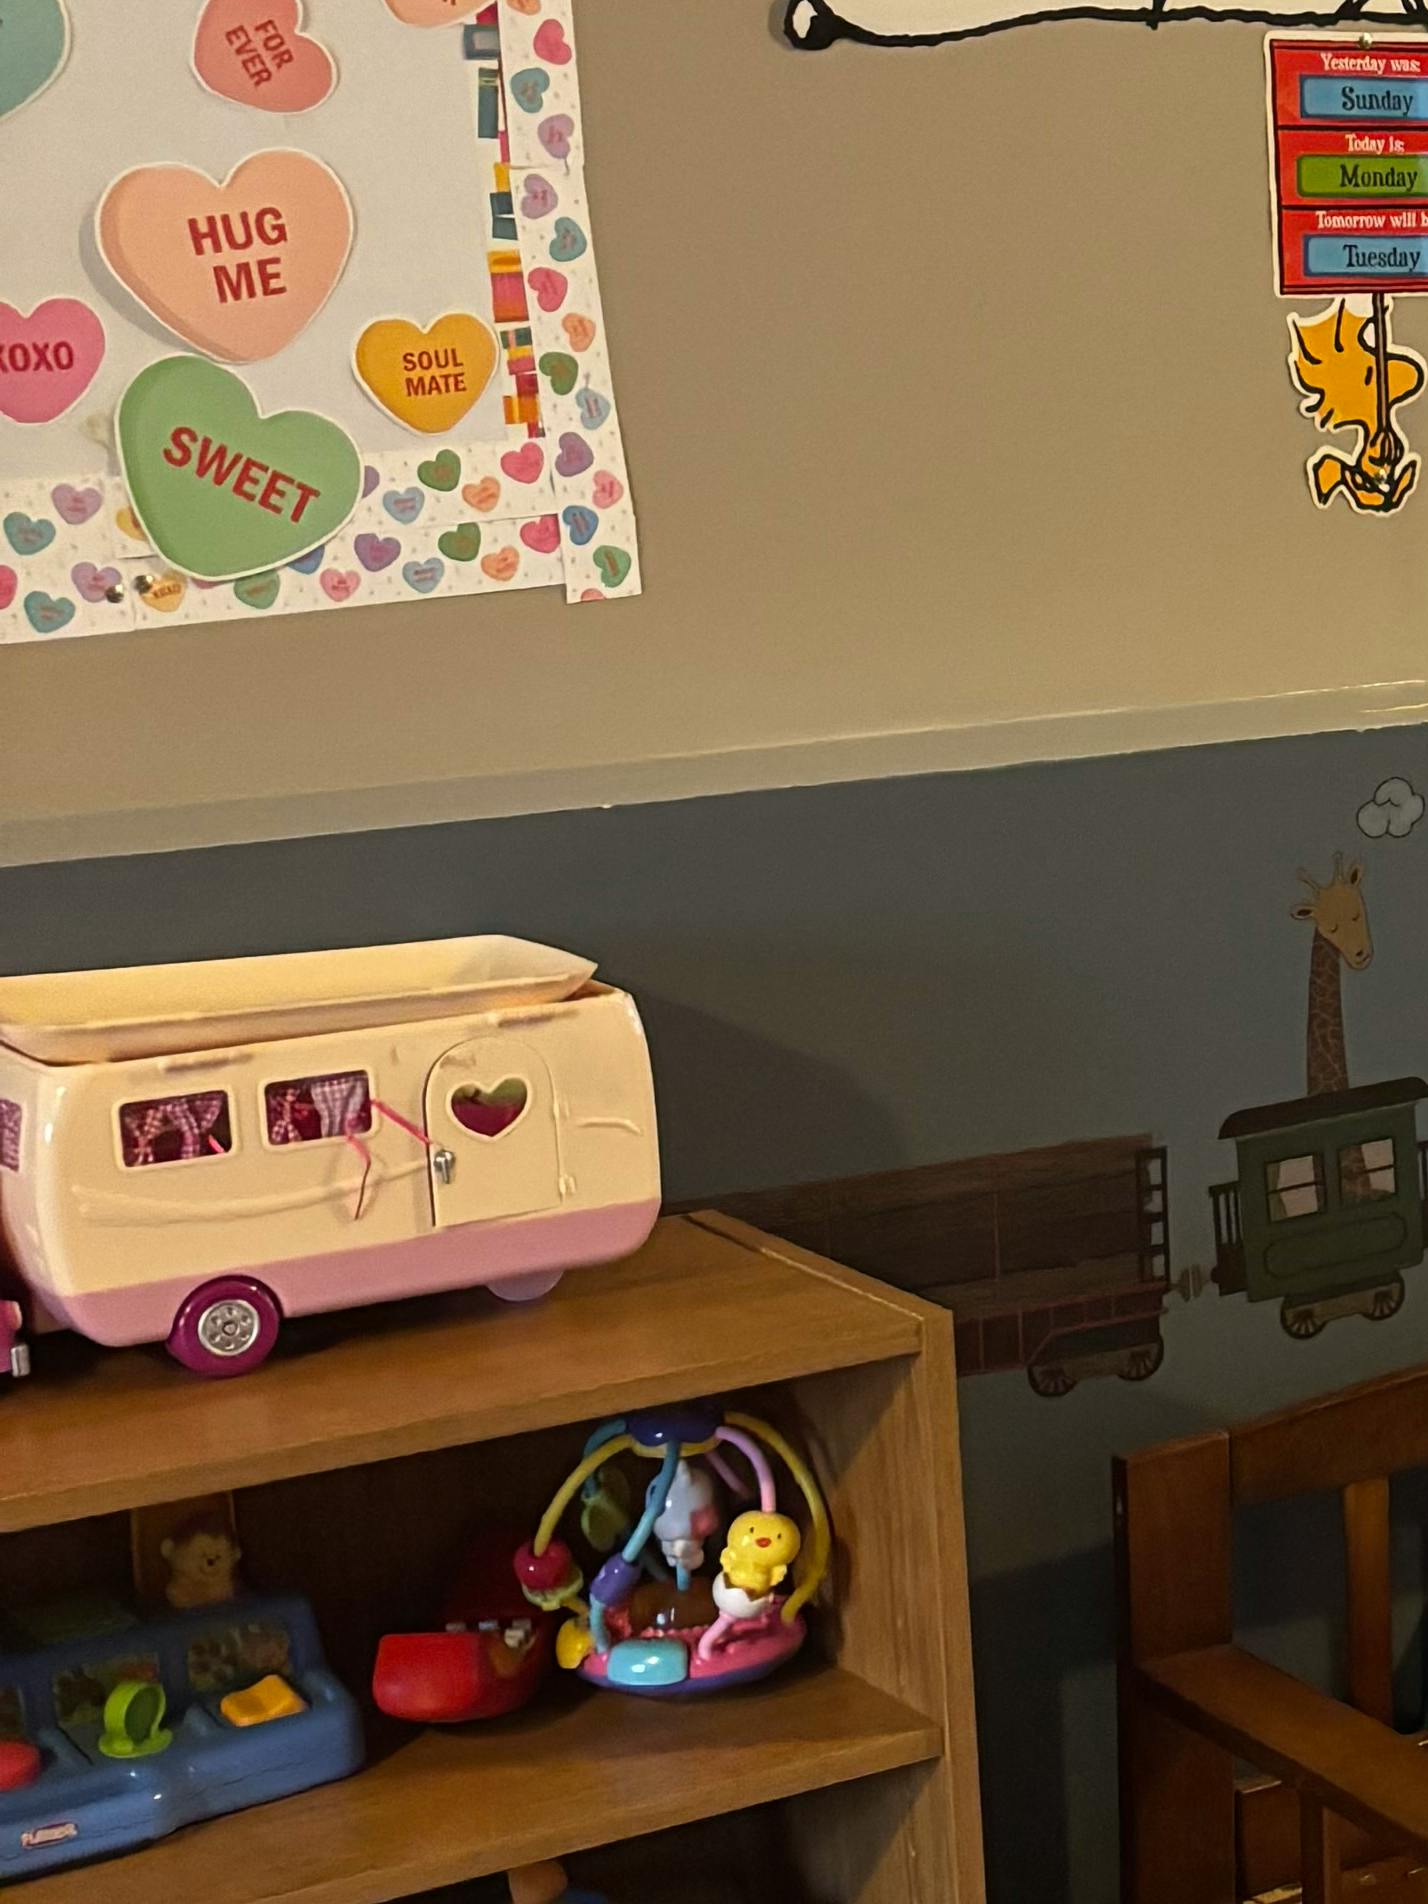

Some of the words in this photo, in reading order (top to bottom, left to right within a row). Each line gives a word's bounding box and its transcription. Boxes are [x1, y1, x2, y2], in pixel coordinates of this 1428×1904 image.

[223, 27, 272, 89] EVER
[253, 17, 295, 71] FOR
[1319, 52, 1386, 75] Yesterday
[1390, 55, 1421, 73] was:
[1340, 85, 1414, 117] Sunday
[1345, 133, 1385, 154] Today
[1388, 135, 1405, 154] is:
[1339, 162, 1419, 192] Monday
[185, 206, 289, 257] HUG
[1315, 210, 1386, 230] Tomorrow
[1389, 211, 1417, 230] will
[1342, 243, 1421, 273] Tuesday
[210, 257, 288, 305] ME
[401, 347, 464, 372] SOUL
[404, 370, 467, 397] MATE
[161, 425, 321, 525] SWEET
